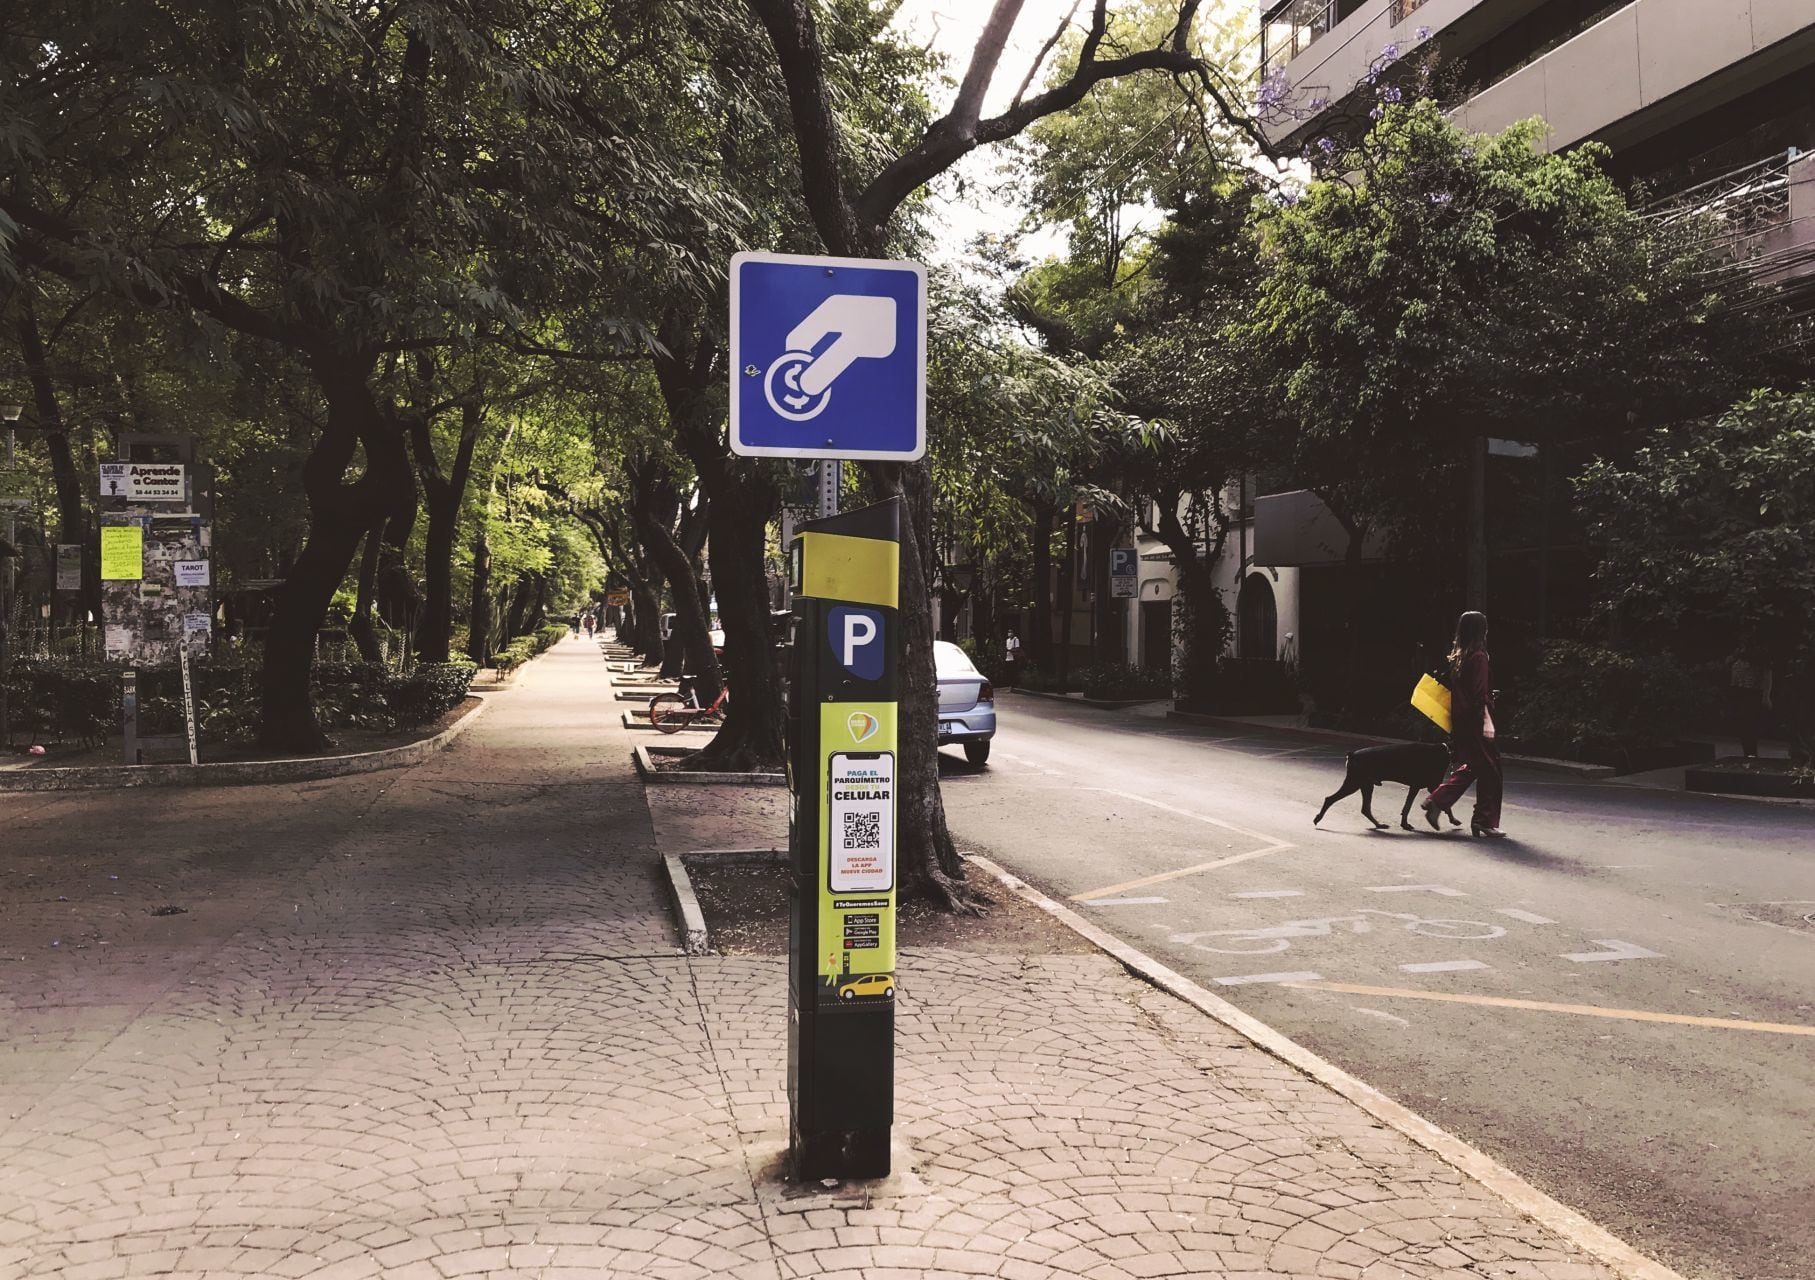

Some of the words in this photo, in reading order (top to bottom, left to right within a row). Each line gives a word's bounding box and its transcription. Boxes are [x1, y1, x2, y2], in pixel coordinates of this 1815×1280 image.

[130, 466, 180, 477] Aprende
[142, 477, 180, 485] Cantar
[1112, 551, 1128, 571] P
[844, 614, 877, 666] P
[834, 776, 890, 784] PARQUÍMETRO
[834, 790, 890, 801] CELULAR
